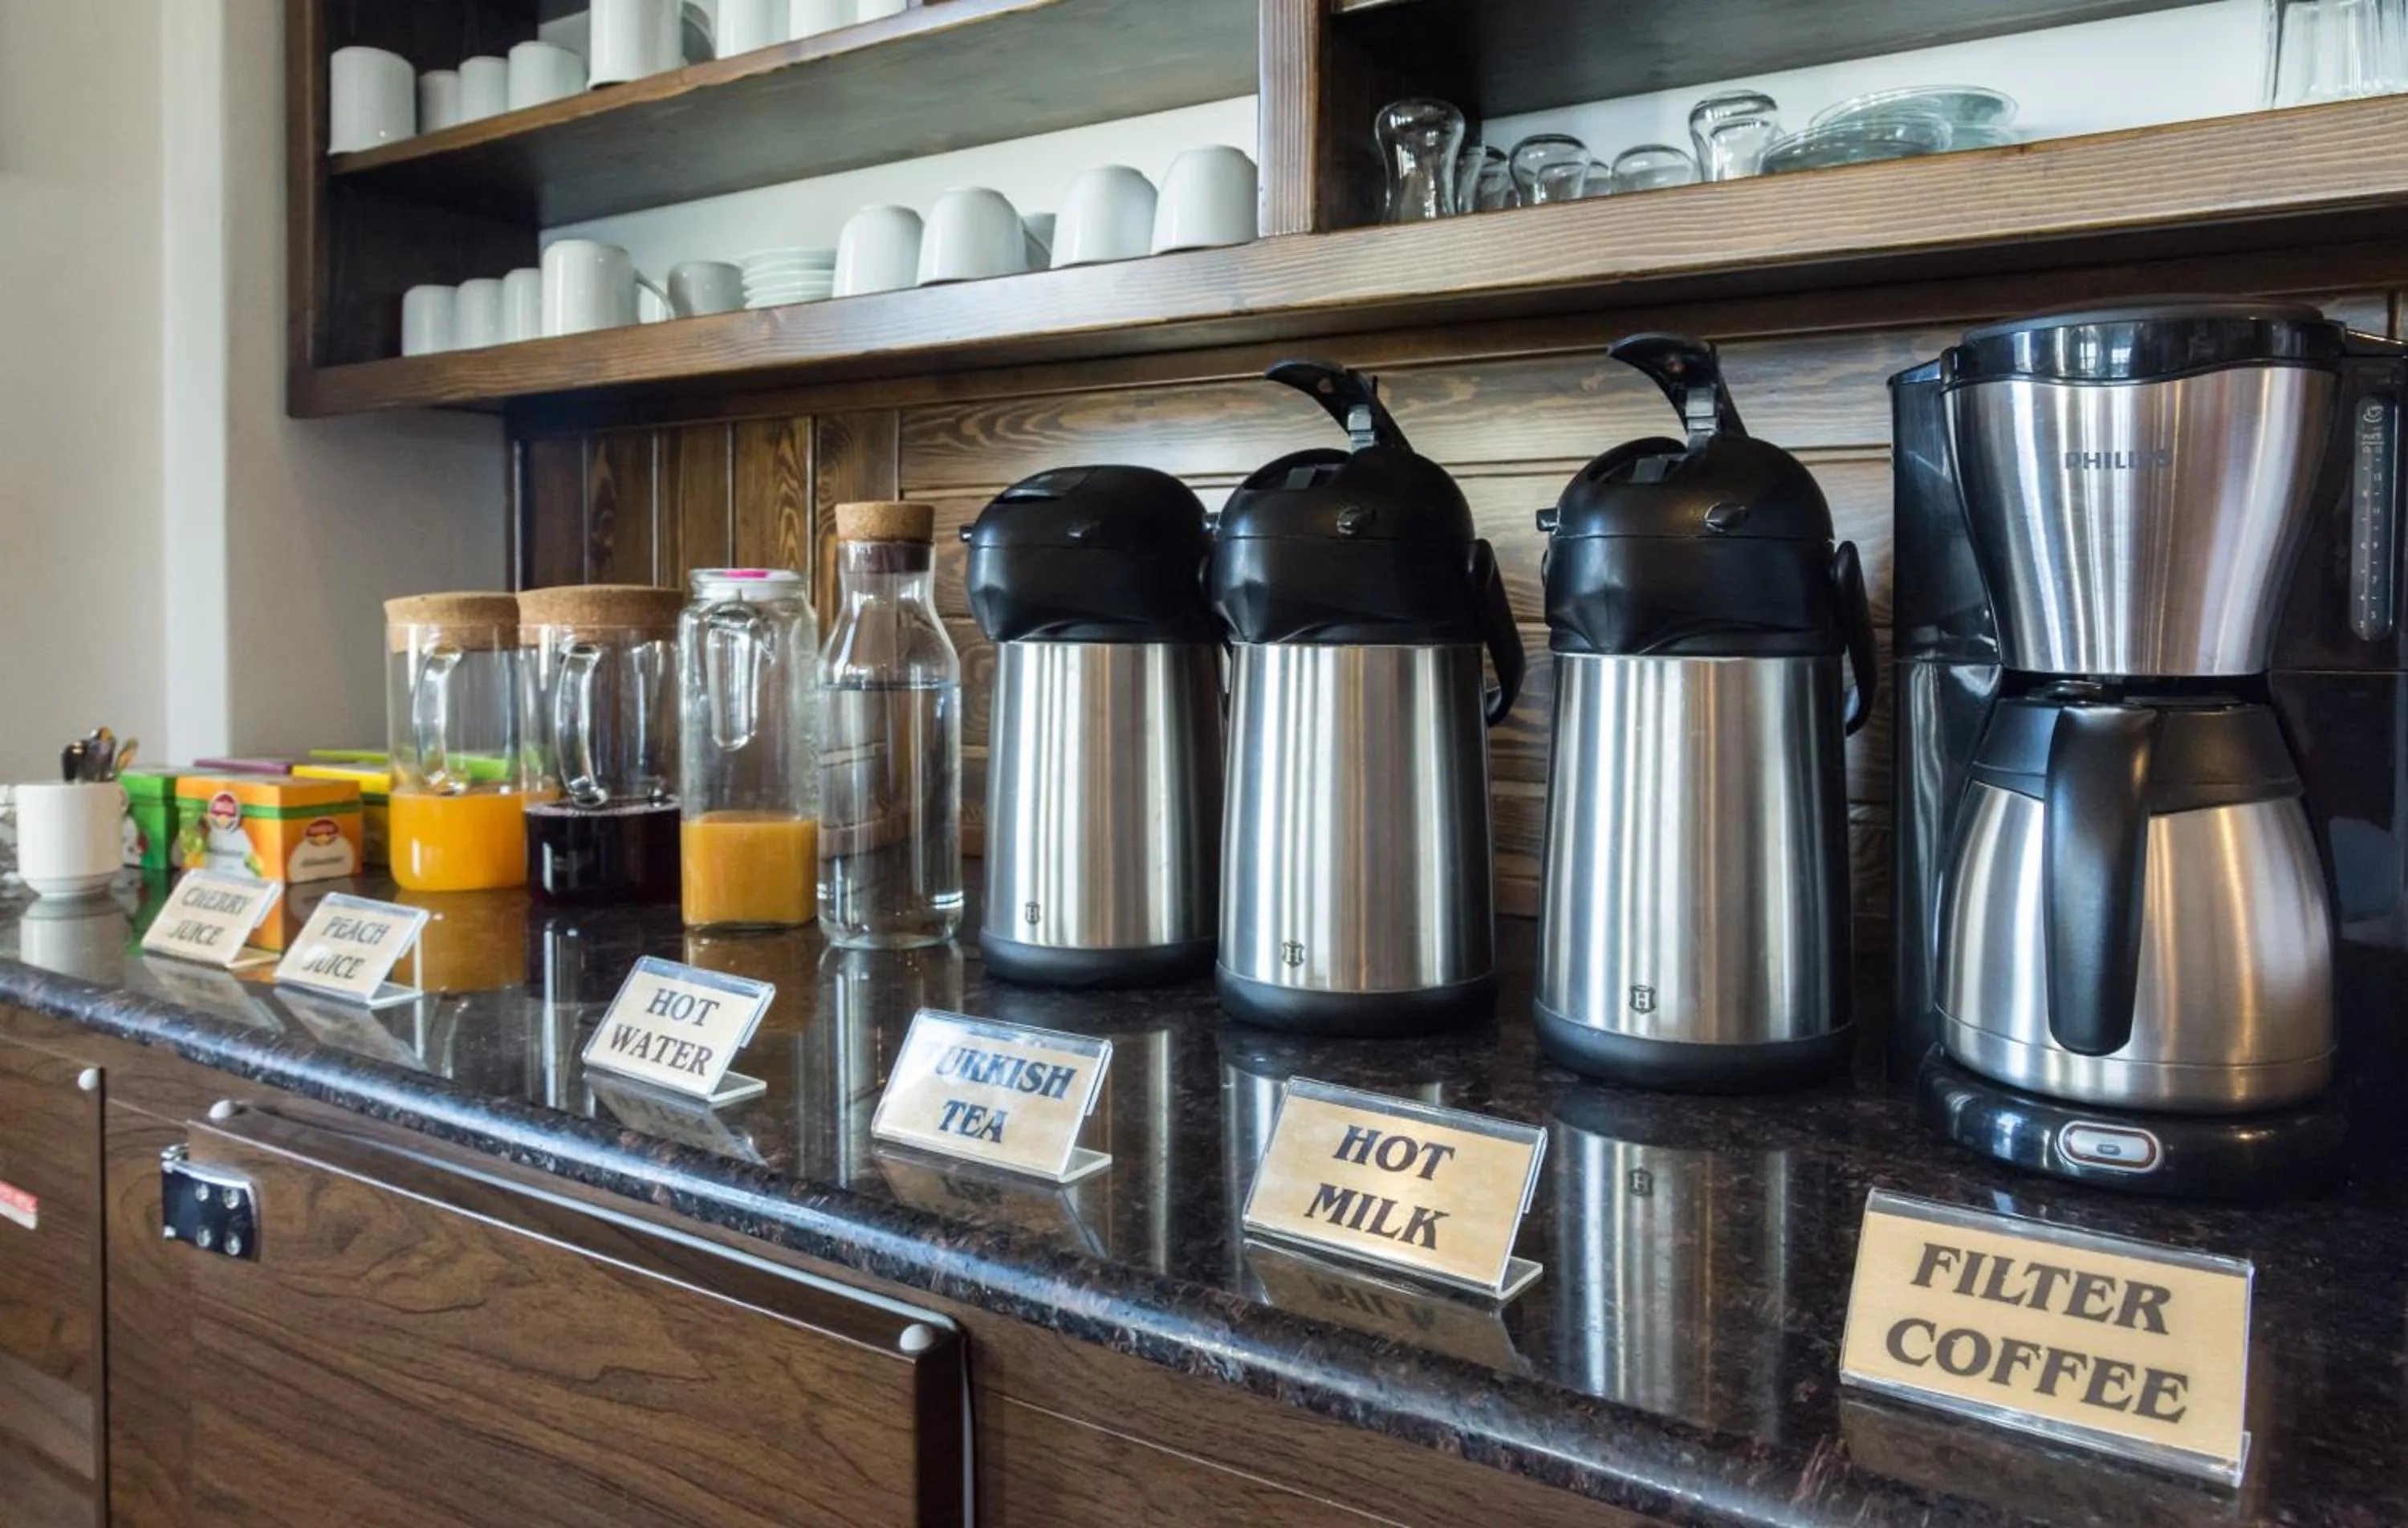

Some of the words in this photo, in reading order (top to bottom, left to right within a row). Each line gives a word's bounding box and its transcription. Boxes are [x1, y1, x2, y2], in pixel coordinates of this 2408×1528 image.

[2065, 449, 2173, 469] PHILIS
[181, 887, 254, 915] CHERRY
[168, 920, 225, 946] JUICE
[321, 916, 392, 945] PEACH
[645, 988, 720, 1027] HOT
[608, 1023, 714, 1077] WATER
[938, 1099, 1008, 1144] TEA
[1332, 1125, 1455, 1181] HOT
[1304, 1182, 1450, 1250] MILK
[1910, 1242, 2172, 1335] FILTER
[1885, 1318, 2189, 1424] COFFEE
